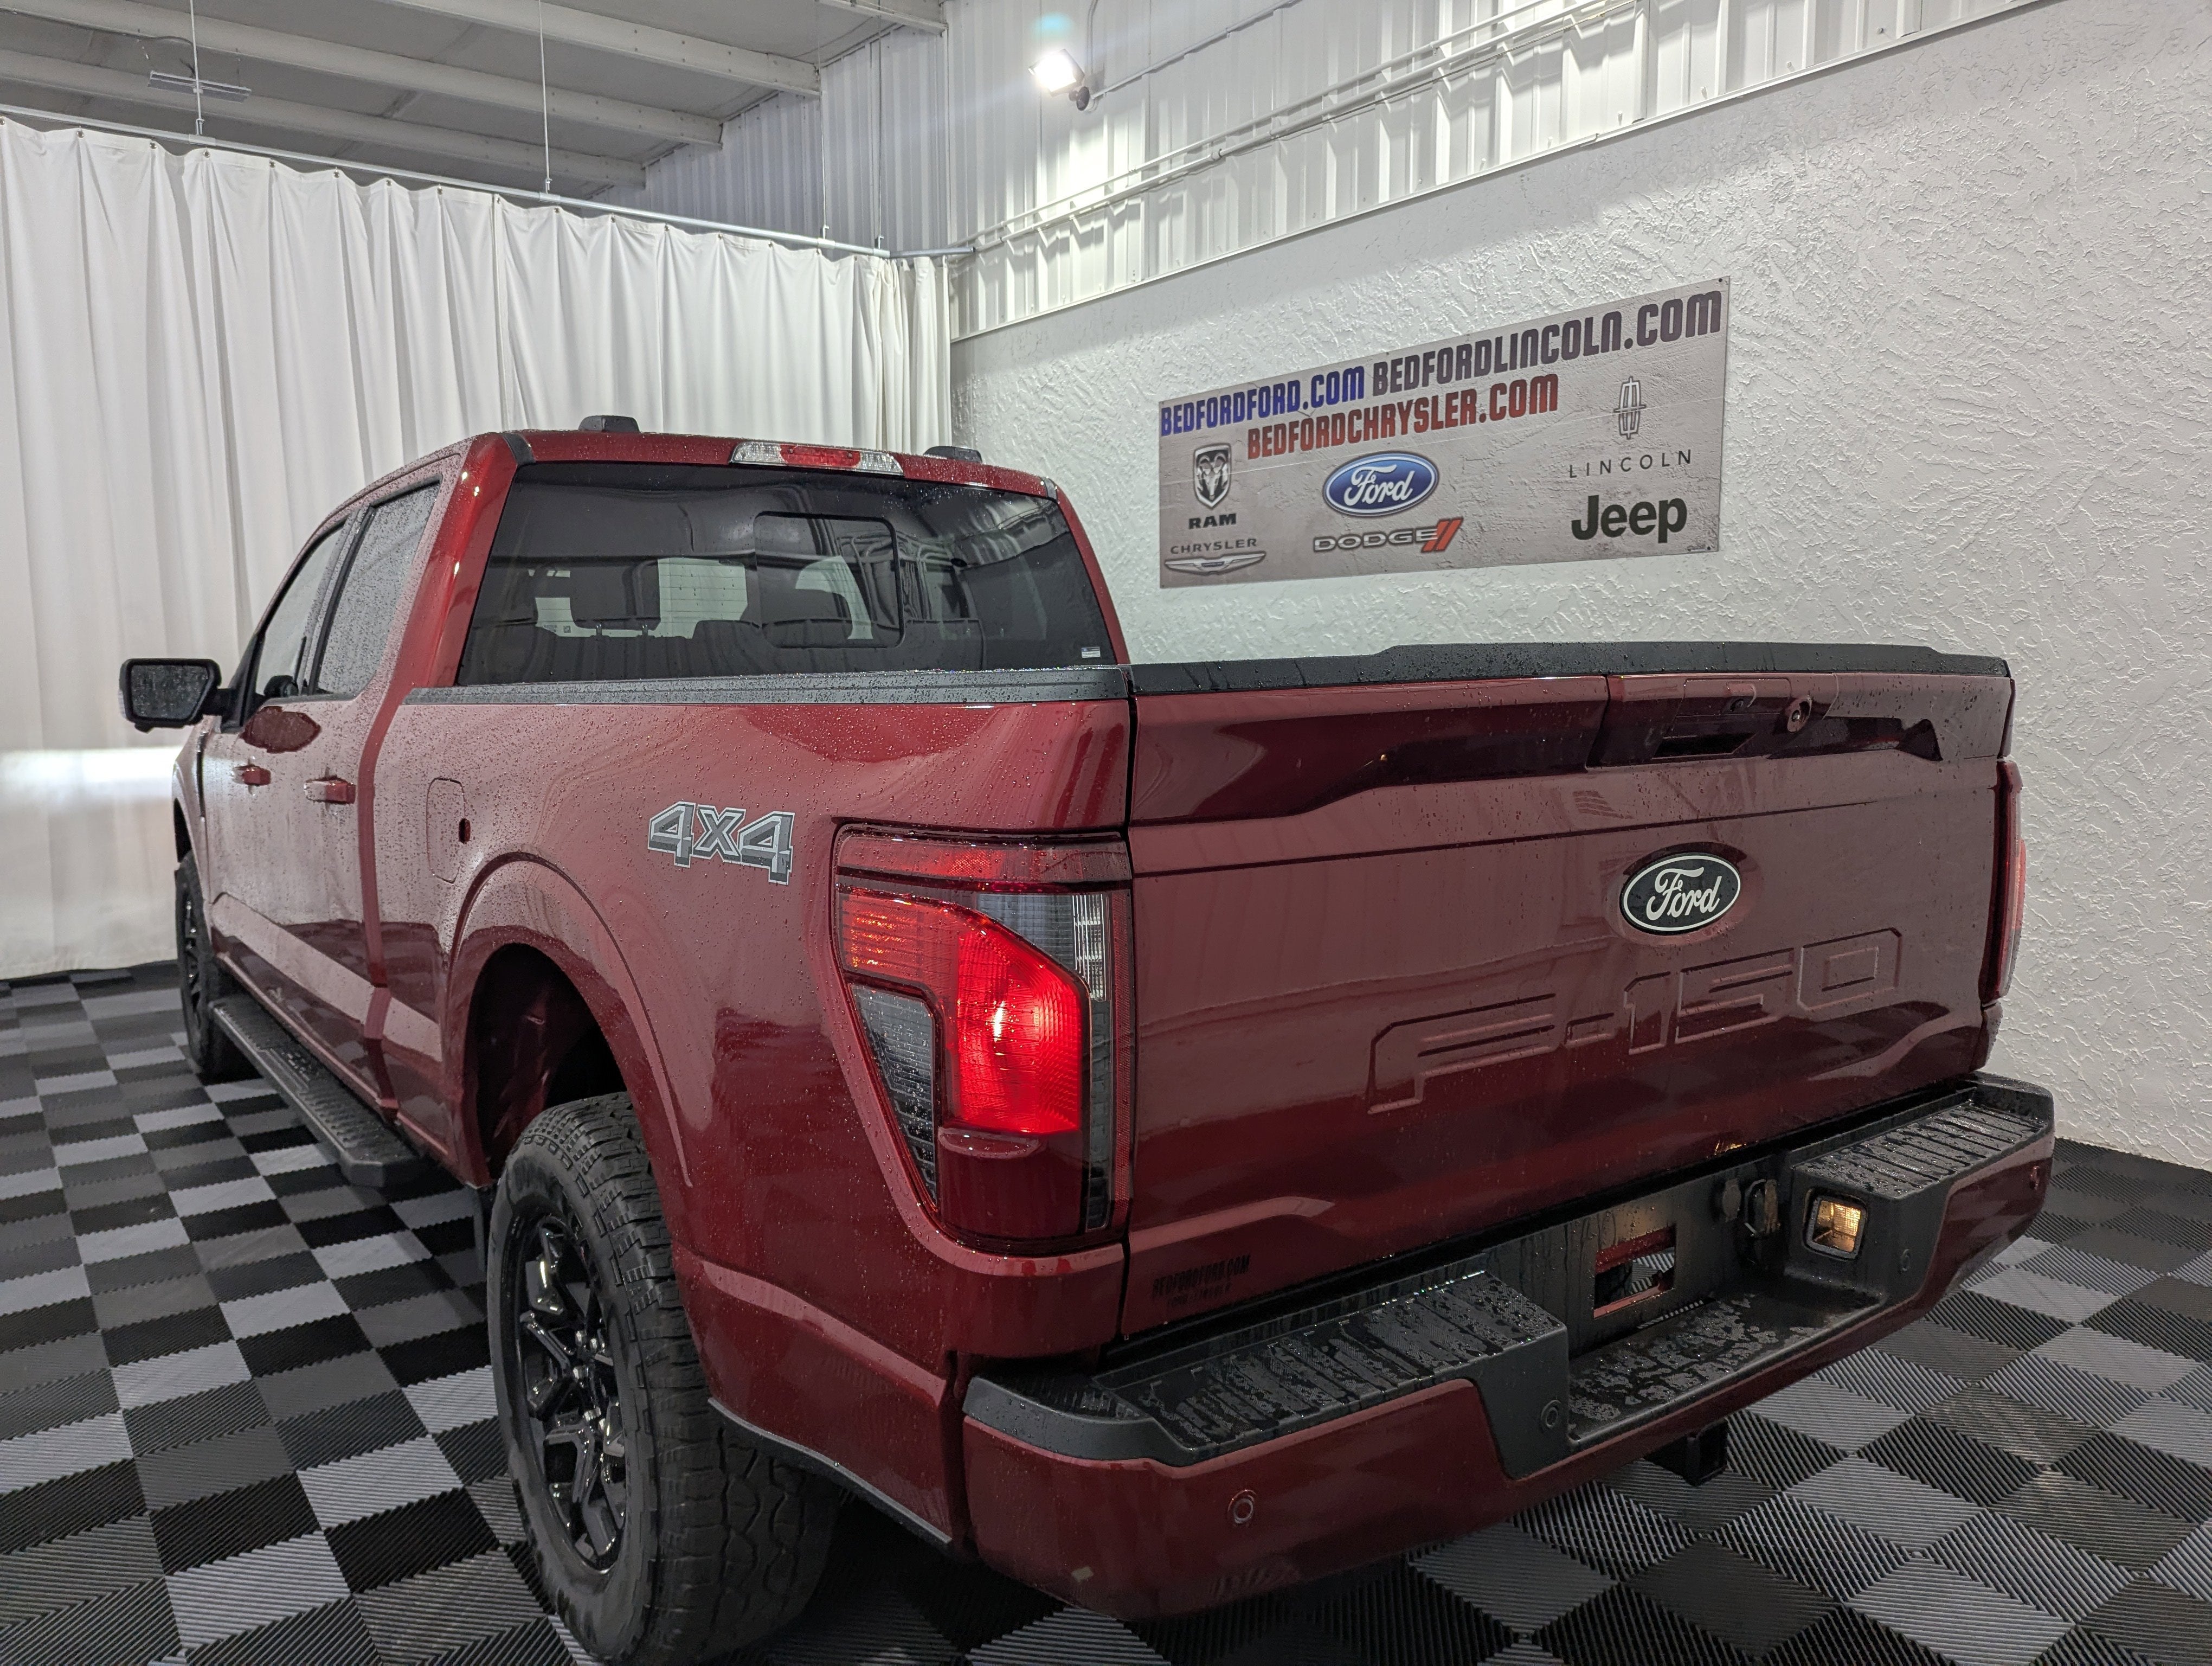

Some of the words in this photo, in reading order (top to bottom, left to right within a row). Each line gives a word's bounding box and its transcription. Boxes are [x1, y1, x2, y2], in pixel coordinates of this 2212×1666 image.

[1161, 366, 1365, 436] BEDFORDFORD.COM
[1372, 290, 1722, 396] BEDFORDLINCOLN.COM
[1248, 373, 1559, 459] BEDFORDCHRYSLER.COM
[1570, 449, 1691, 478] LINCOLN
[1343, 464, 1415, 506] Ford
[1188, 513, 1237, 529] RAM
[1313, 526, 1438, 552] DODGE
[1571, 495, 1688, 544] Jeep
[1170, 538, 1257, 554] CHRYSLER
[1646, 867, 1722, 921] Ford
